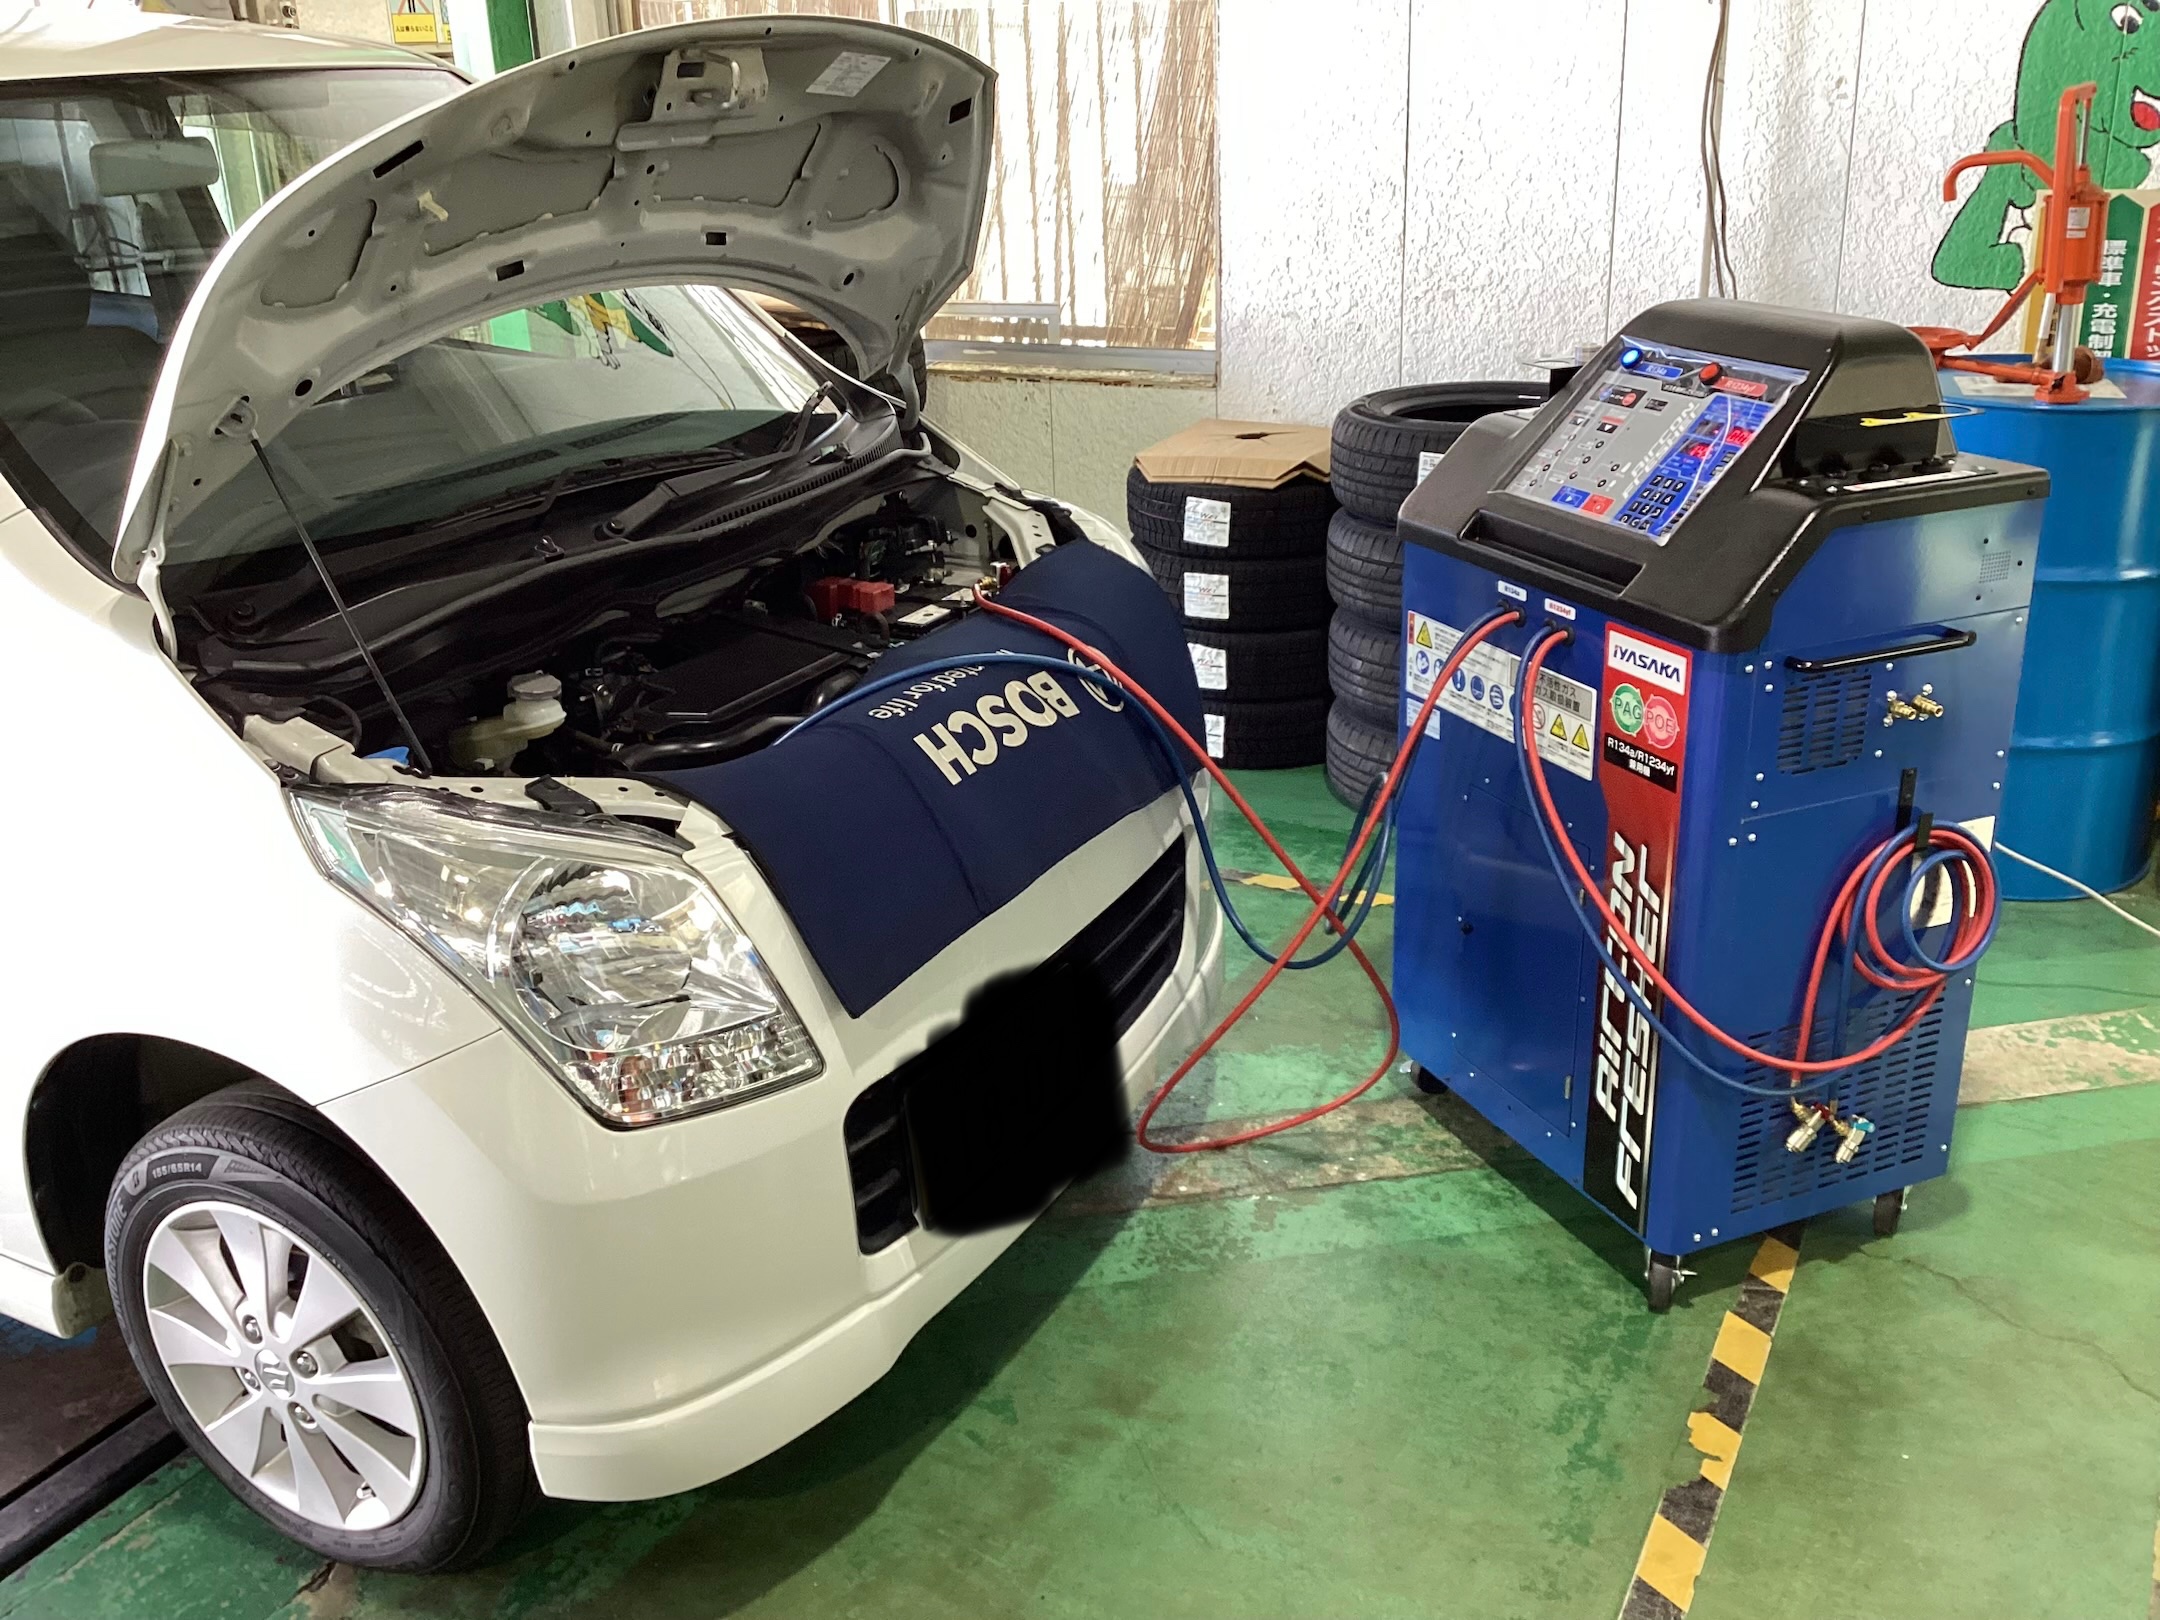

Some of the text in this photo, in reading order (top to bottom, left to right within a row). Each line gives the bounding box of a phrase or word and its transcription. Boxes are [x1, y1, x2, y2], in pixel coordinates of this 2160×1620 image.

[868, 698, 919, 720] life
[1613, 696, 1643, 721] PAG
[913, 671, 1080, 786] BOSCH
[1646, 709, 1676, 737] POE
[1607, 736, 1675, 777] R134a/R1234yf
[152, 1162, 203, 1180] 155/65R14
